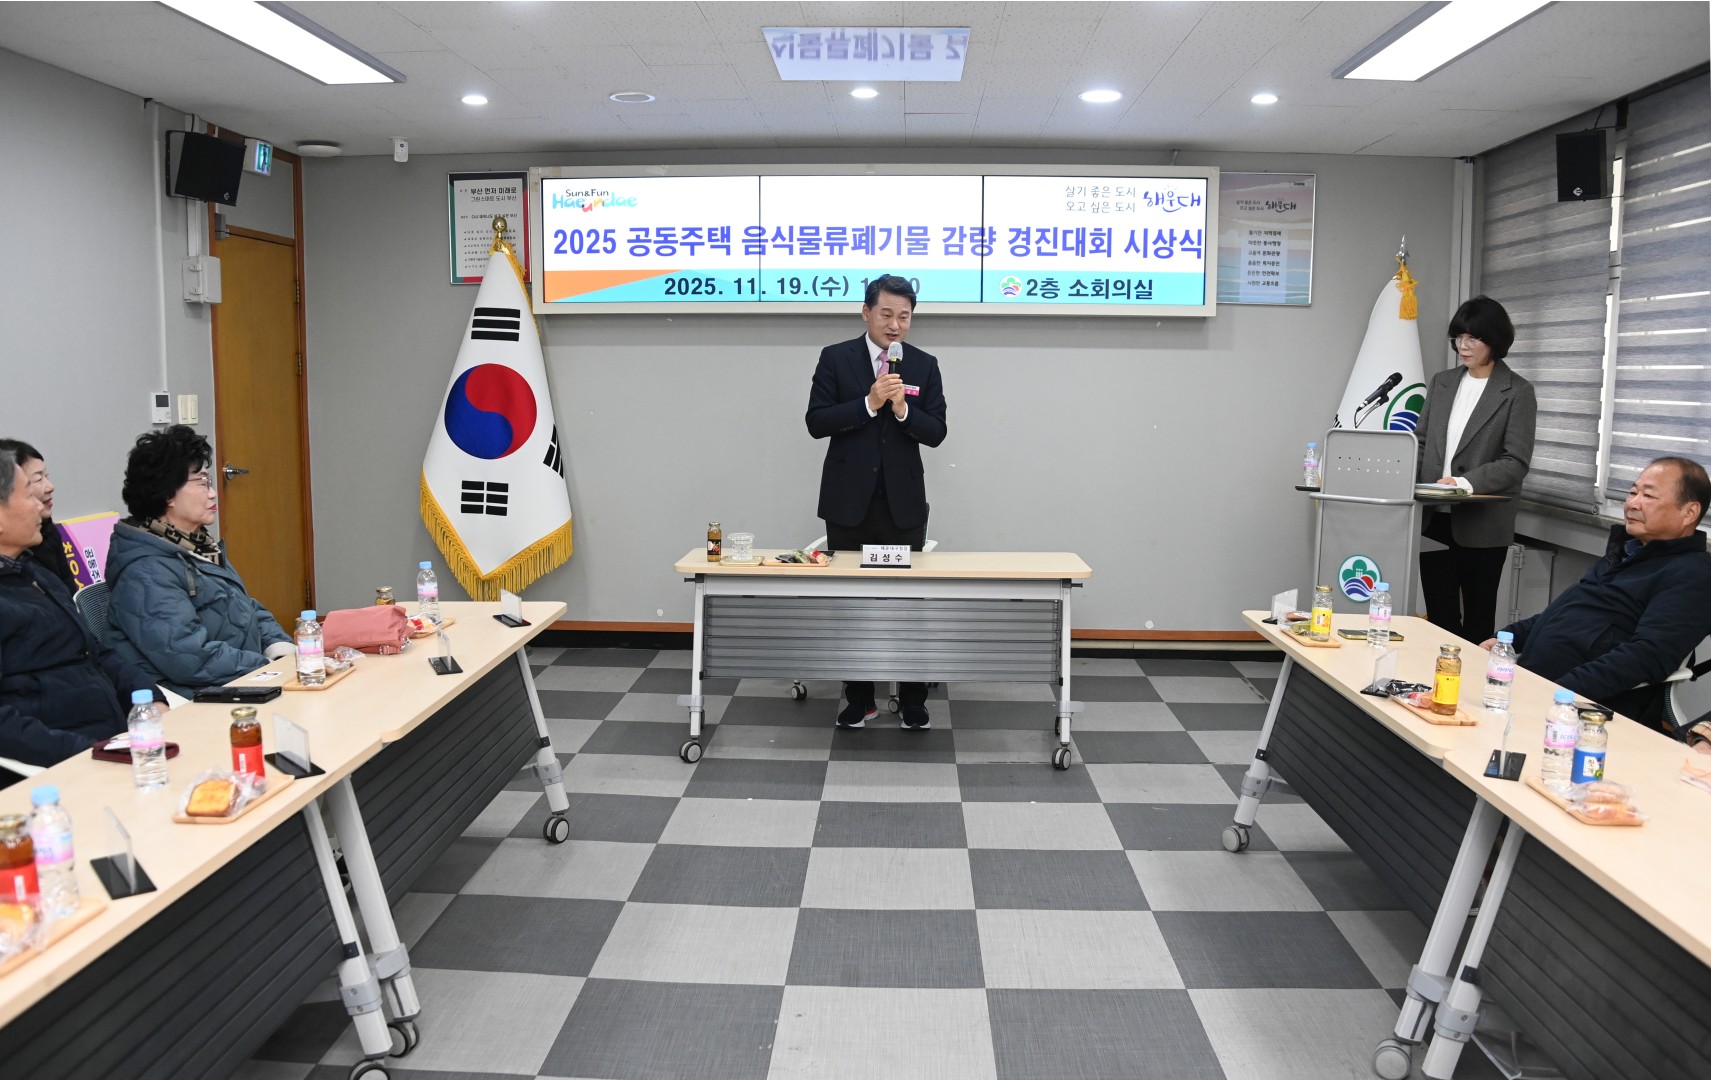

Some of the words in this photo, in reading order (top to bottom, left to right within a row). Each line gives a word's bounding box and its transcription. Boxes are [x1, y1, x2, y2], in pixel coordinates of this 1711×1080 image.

[499, 186, 517, 194] 미래로
[565, 189, 609, 197] Sun&Fun
[1065, 186, 1087, 198] 살기
[1090, 186, 1111, 198] 좋은
[1115, 186, 1136, 198] 도시
[552, 191, 638, 212] Haeundae
[1065, 201, 1087, 212] 오고
[1090, 201, 1111, 213] 싶은
[1115, 202, 1136, 213] 도시
[1142, 190, 1202, 213] 해운대
[1265, 200, 1297, 213] 해운대
[553, 228, 617, 255] 2025
[627, 225, 731, 257] 공동주택
[742, 225, 931, 256] 음식물류폐기물
[942, 225, 997, 257] 감량
[1008, 226, 1113, 258] 경진대회
[1123, 228, 1203, 260] 시상식
[664, 277, 723, 296] 2025.
[734, 277, 767, 295] 11.
[777, 275, 849, 298] 19.(수)
[1026, 277, 1061, 299] 2층
[1067, 278, 1153, 300] 소회의실
[84, 548, 101, 582] 공동주
